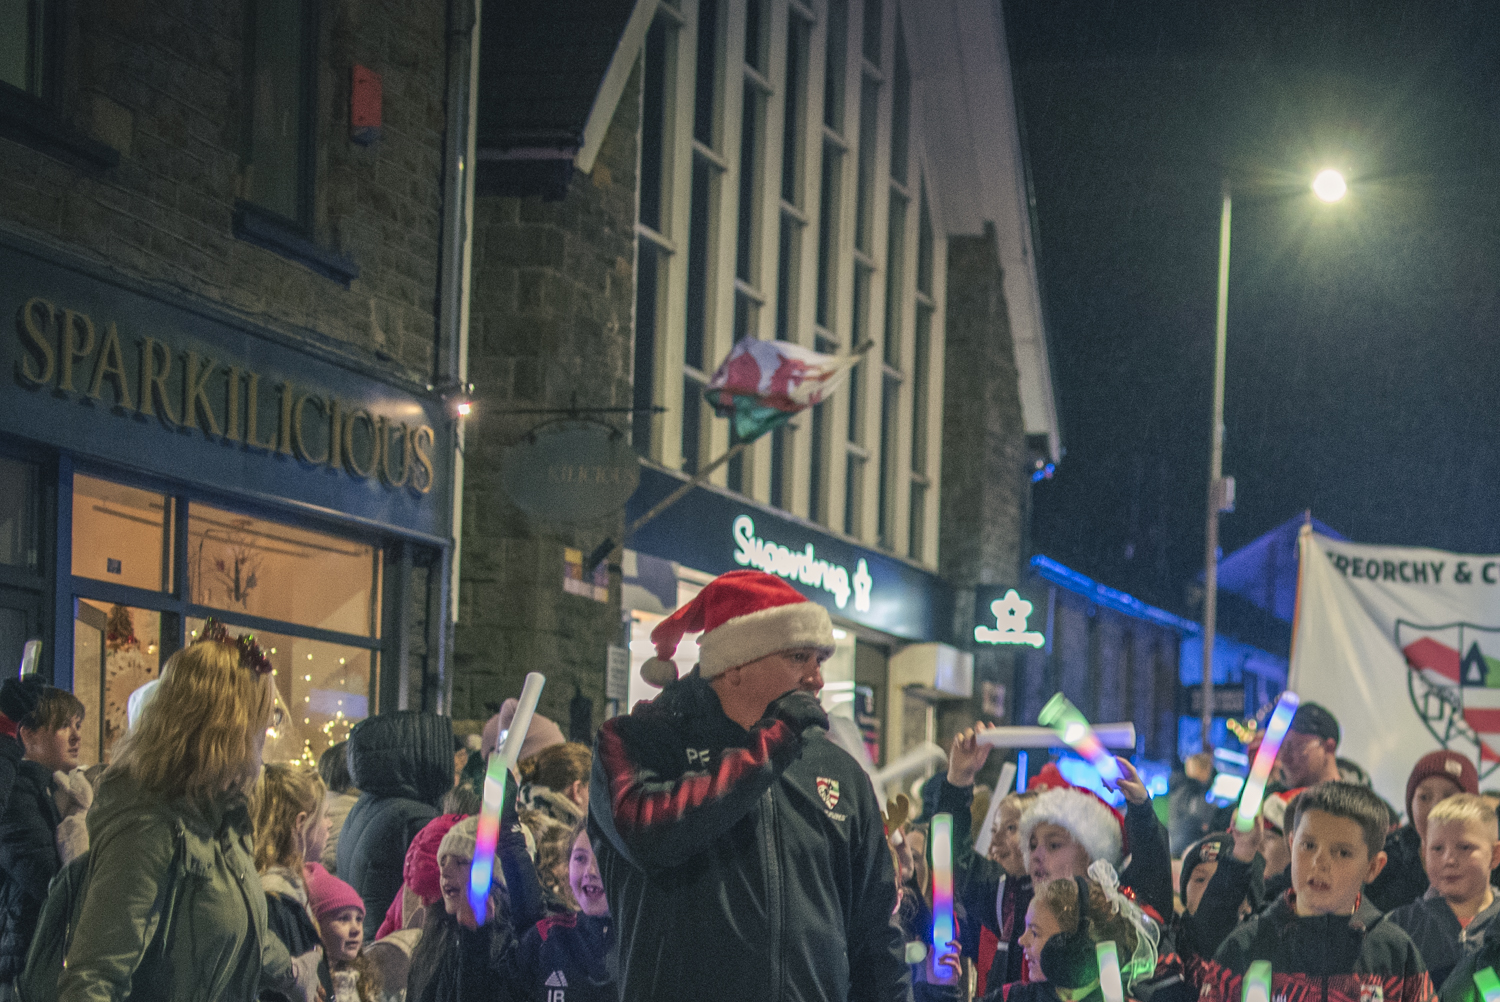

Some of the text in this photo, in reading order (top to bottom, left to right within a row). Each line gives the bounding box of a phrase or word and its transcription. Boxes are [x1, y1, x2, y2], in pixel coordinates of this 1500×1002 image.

[17, 296, 435, 495] SPARKILICIOUS
[733, 514, 851, 609] Superdrug
[1454, 561, 1472, 584] &
